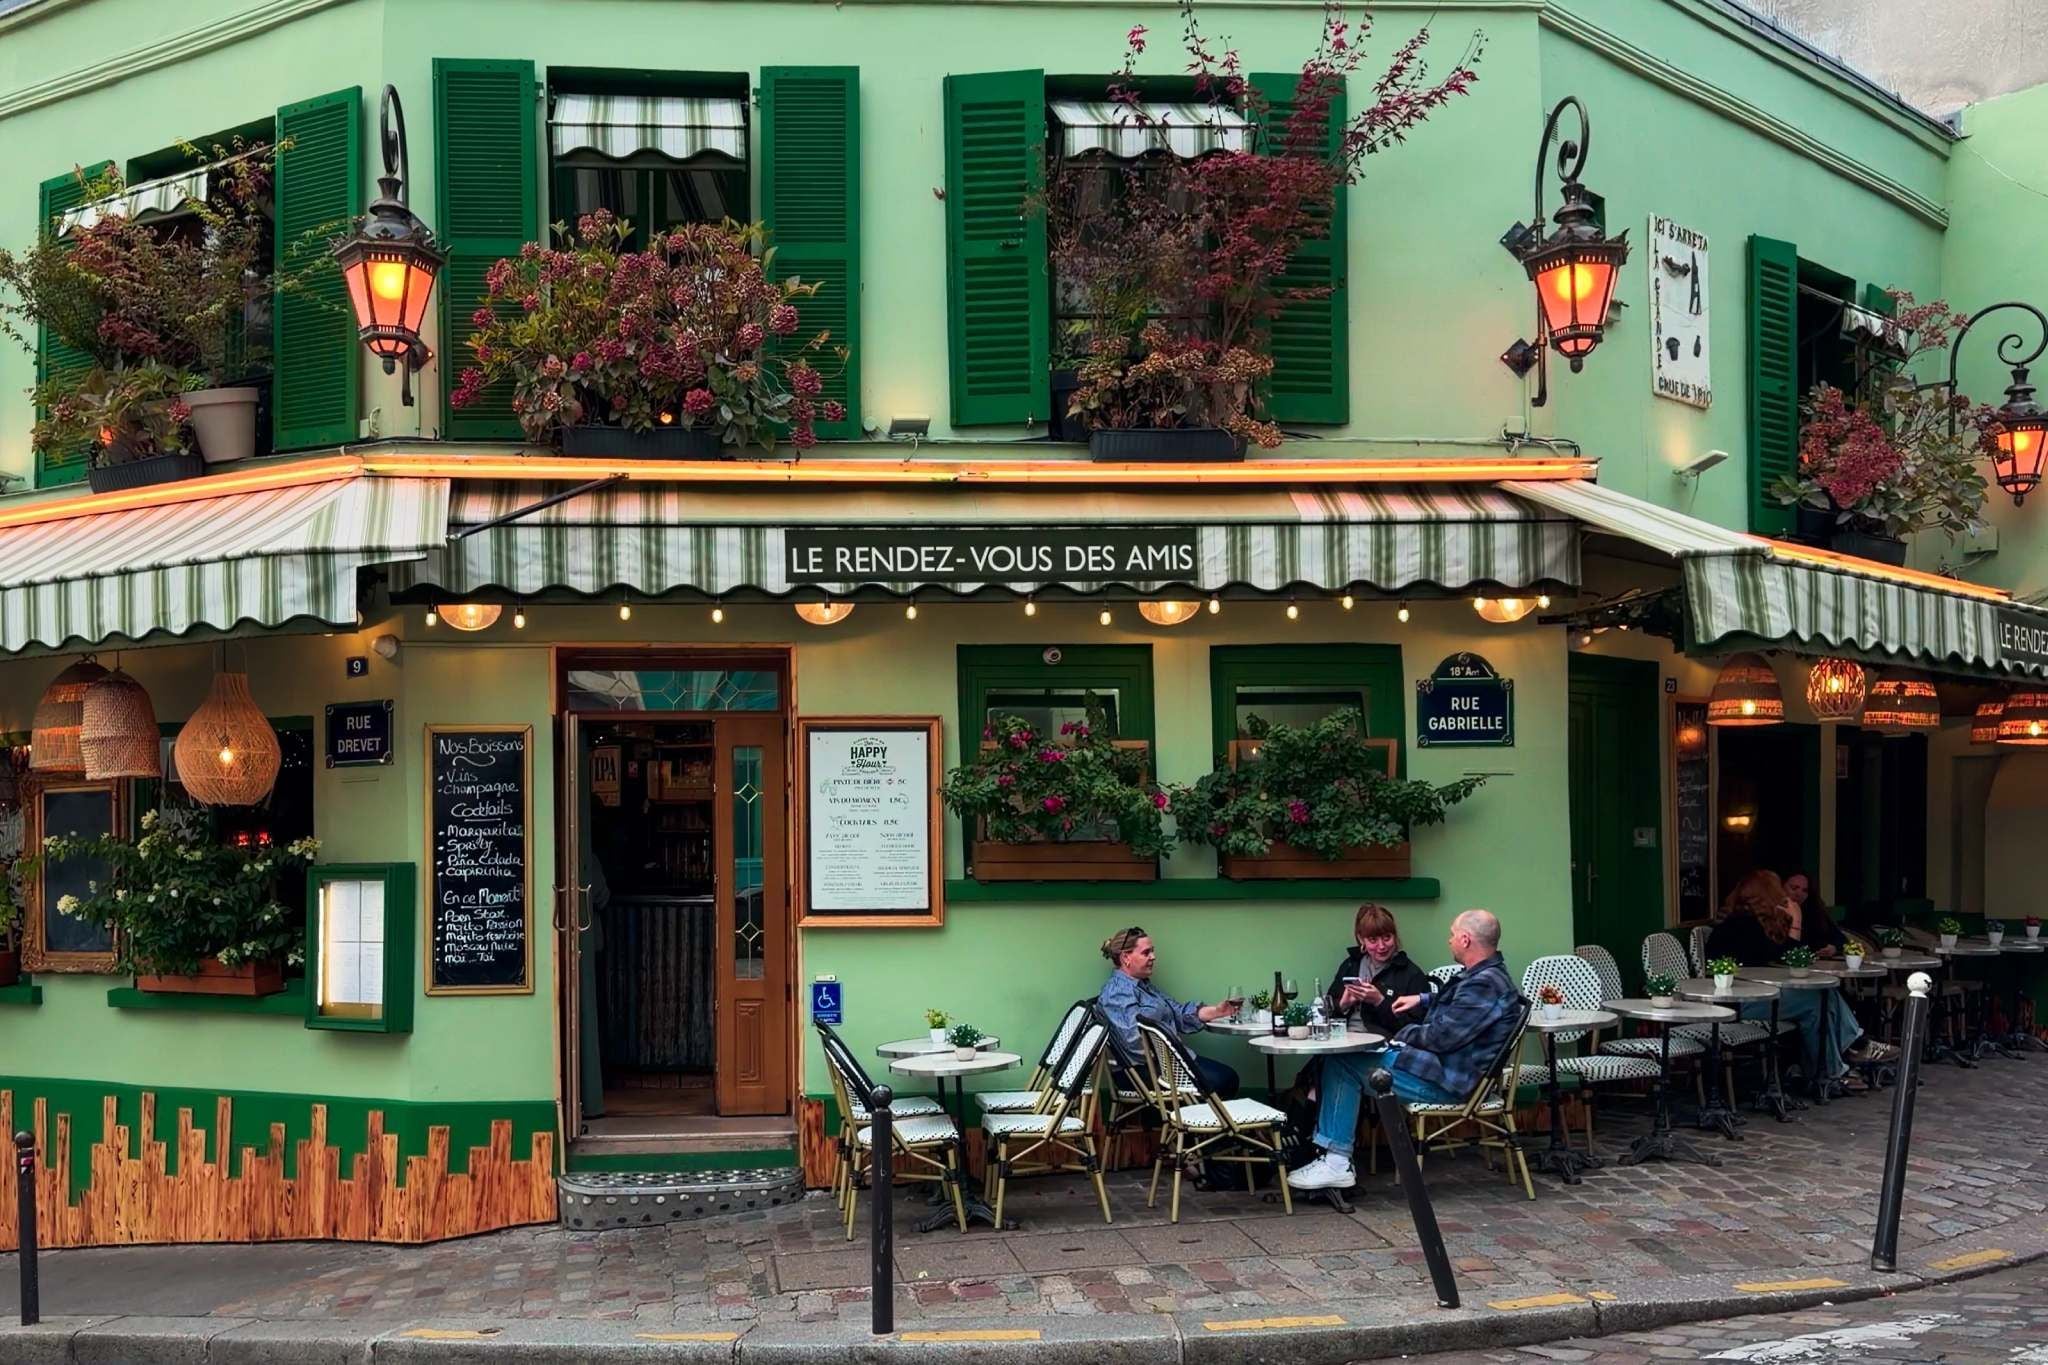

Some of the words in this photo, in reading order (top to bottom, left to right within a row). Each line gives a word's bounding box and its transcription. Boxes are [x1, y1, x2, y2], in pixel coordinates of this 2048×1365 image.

[1658, 376, 1679, 396] CRUE
[791, 547, 823, 573] LE
[835, 545, 1053, 573] RENDEZ-VOUS
[1065, 545, 1115, 572] DES
[1126, 544, 1193, 571] AMIS
[2000, 622, 2012, 649] LE
[353, 660, 361, 673] 9
[1451, 696, 1480, 711] RUE
[346, 715, 371, 730] RUE
[1428, 716, 1503, 730] GABRIELLE
[337, 737, 381, 753] DREVET
[850, 746, 887, 760] HAPPY
[595, 757, 616, 781] IPA
[856, 759, 882, 770] Hour
